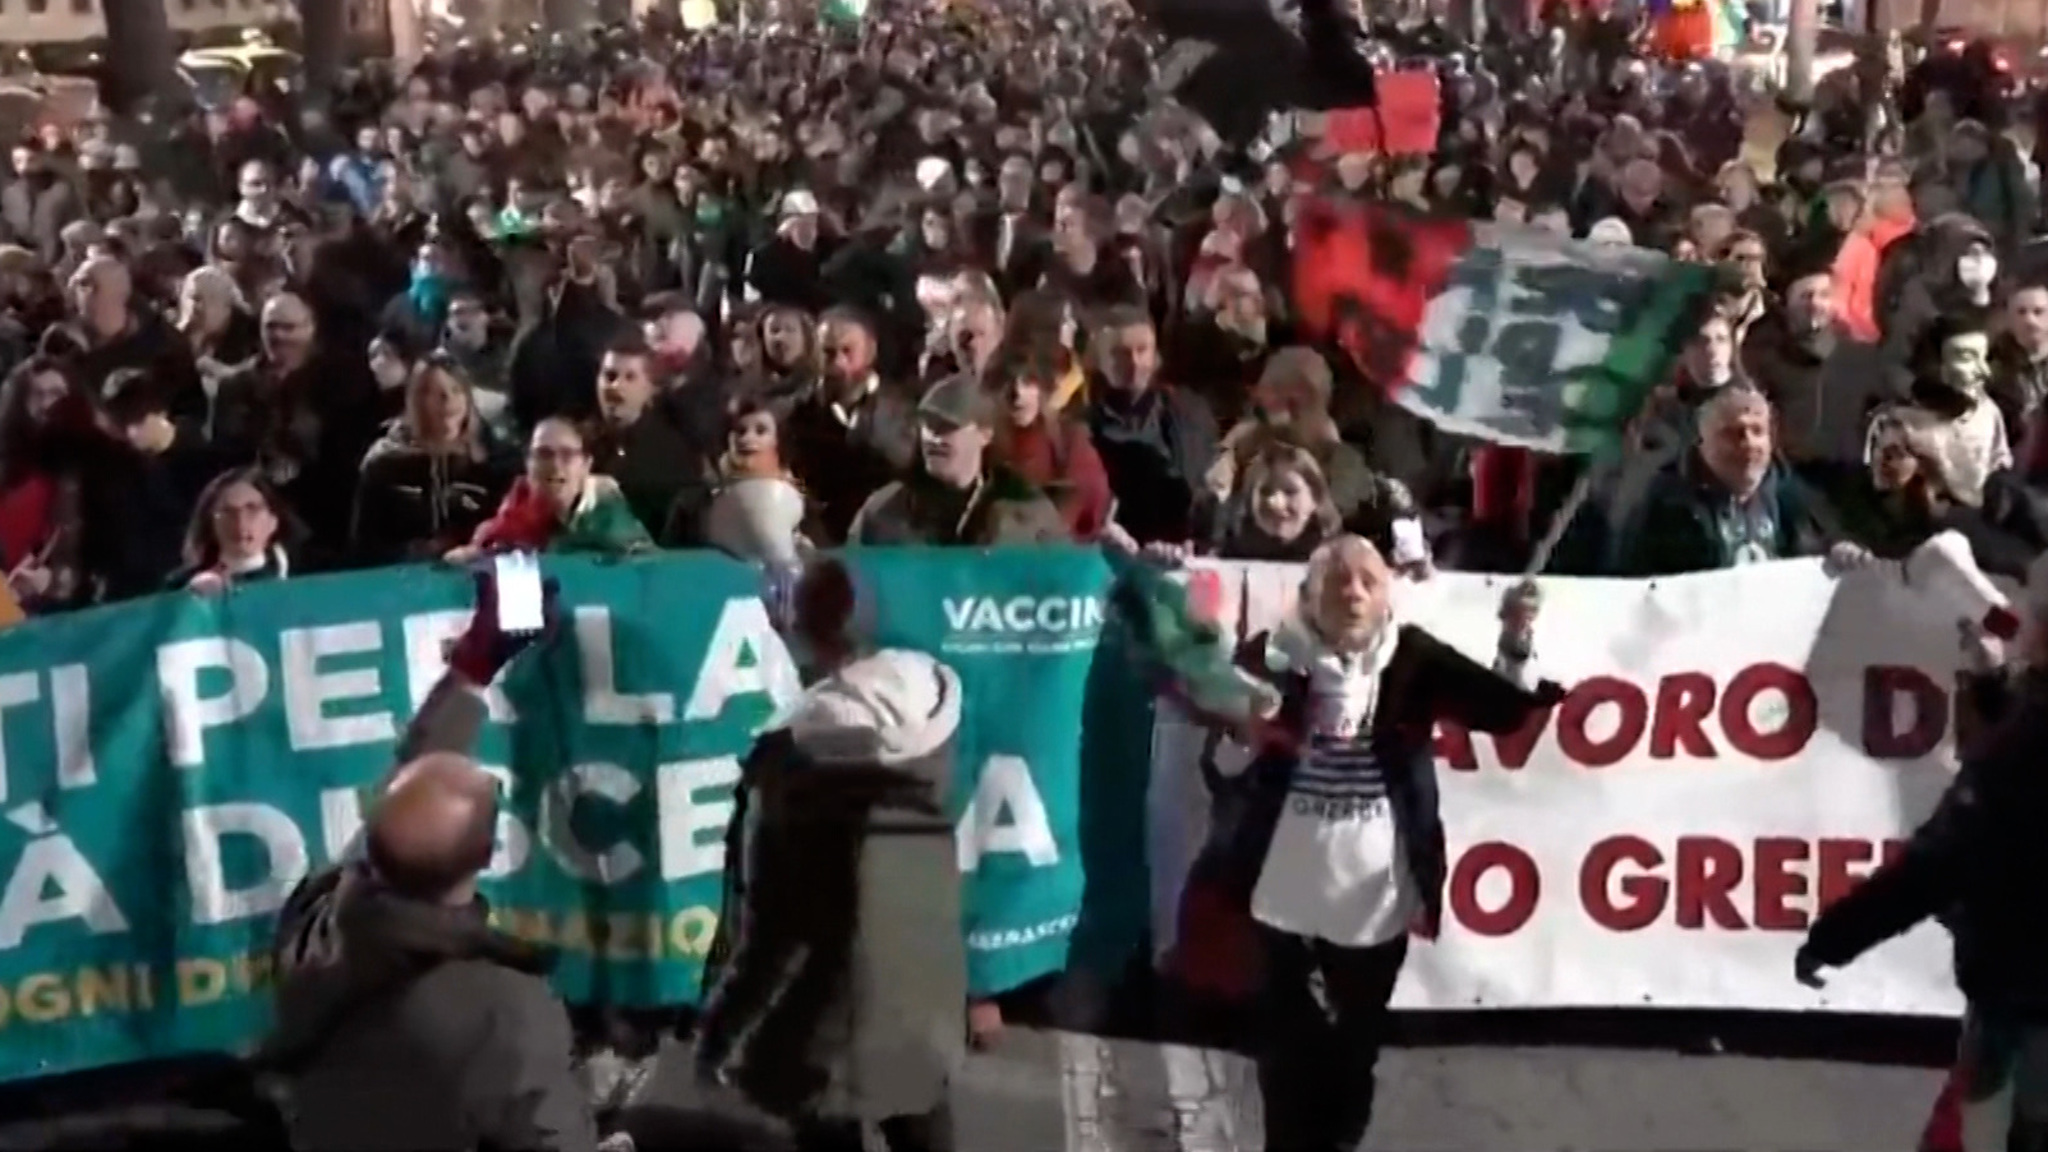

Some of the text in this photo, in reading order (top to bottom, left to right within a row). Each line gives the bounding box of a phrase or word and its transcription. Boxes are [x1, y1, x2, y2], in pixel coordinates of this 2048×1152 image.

[574, 596, 803, 724] LA
[1579, 835, 1912, 932] GREE
[0, 962, 153, 1022] GNI
